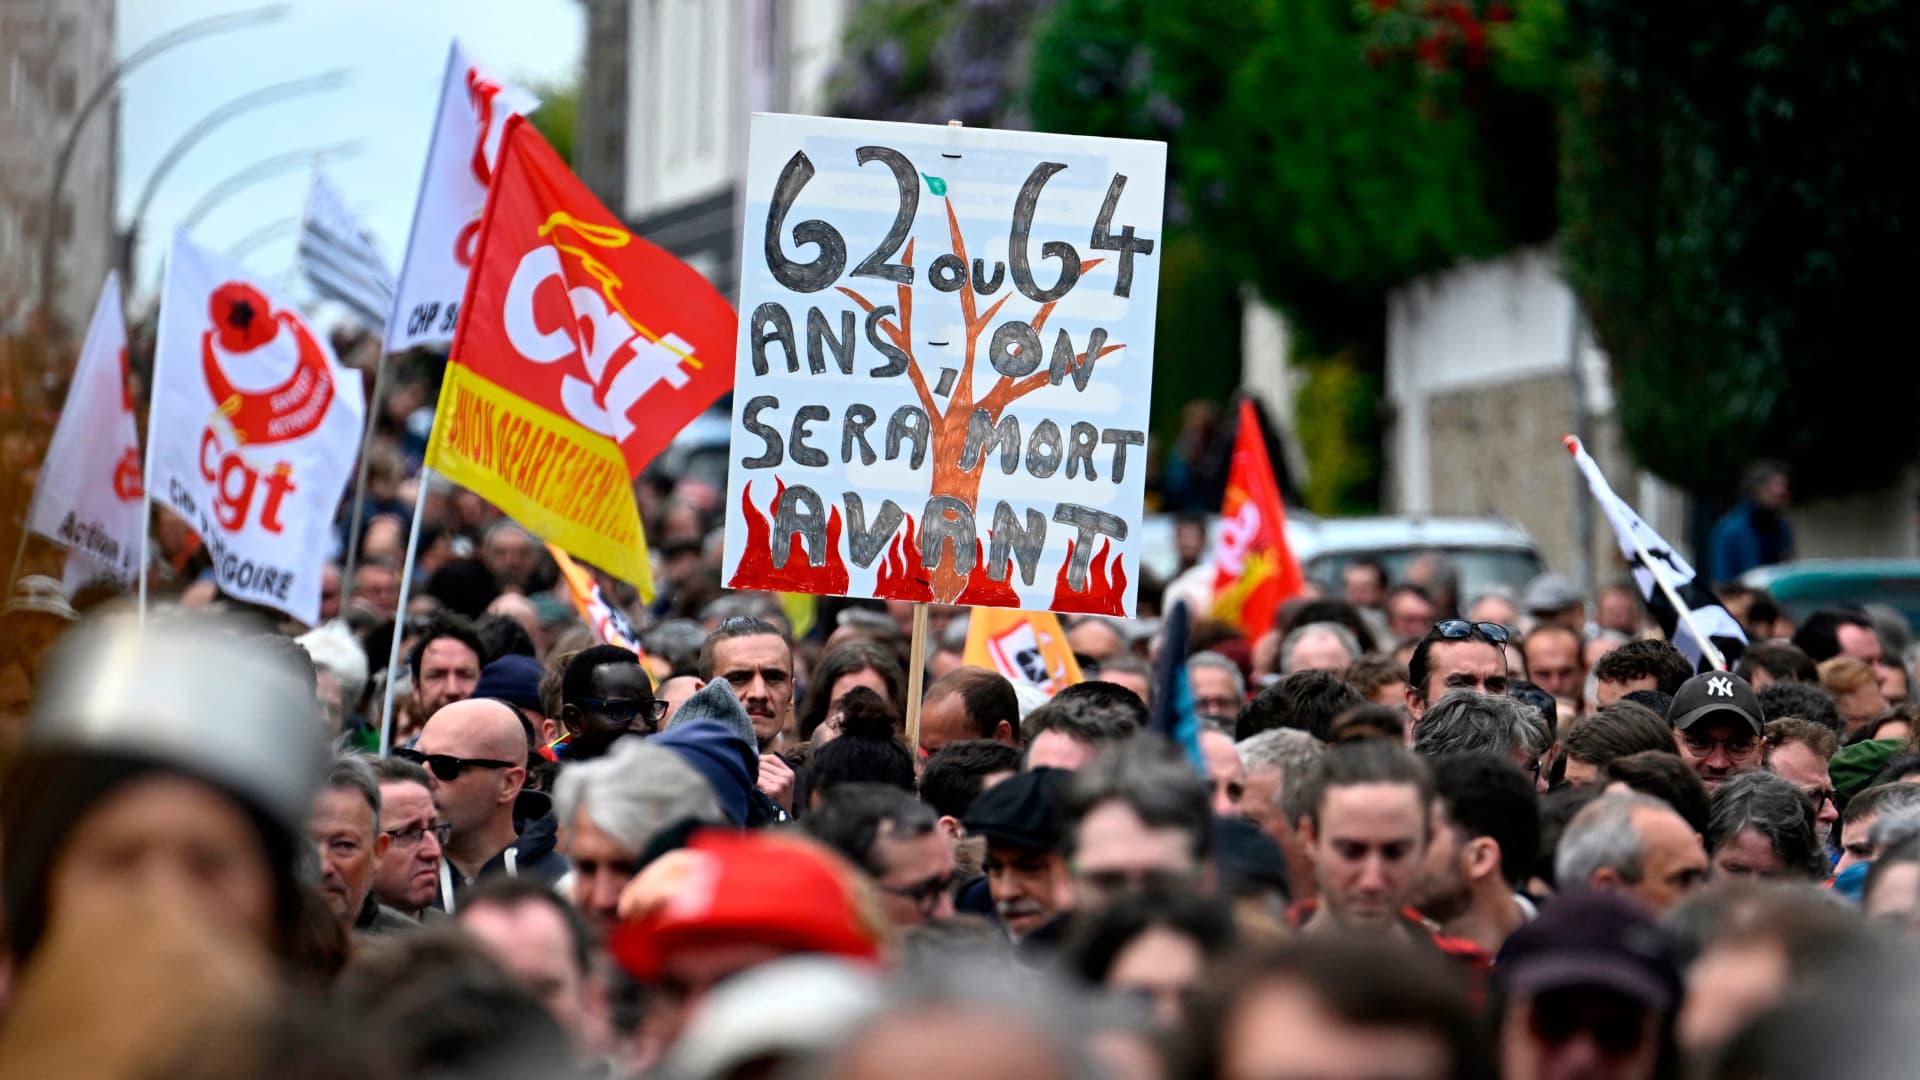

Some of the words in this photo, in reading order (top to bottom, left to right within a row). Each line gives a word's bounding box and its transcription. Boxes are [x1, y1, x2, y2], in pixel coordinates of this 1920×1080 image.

[764, 146, 919, 293] 62
[928, 254, 1006, 295] ou
[1008, 162, 1155, 302] 64
[503, 244, 697, 445] cgt
[989, 320, 1108, 392] ON
[199, 425, 296, 535] cgt
[741, 395, 931, 470] SERA
[957, 407, 1145, 484] MORT
[771, 484, 1128, 593] AVANT
[1706, 676, 1734, 697] NY
